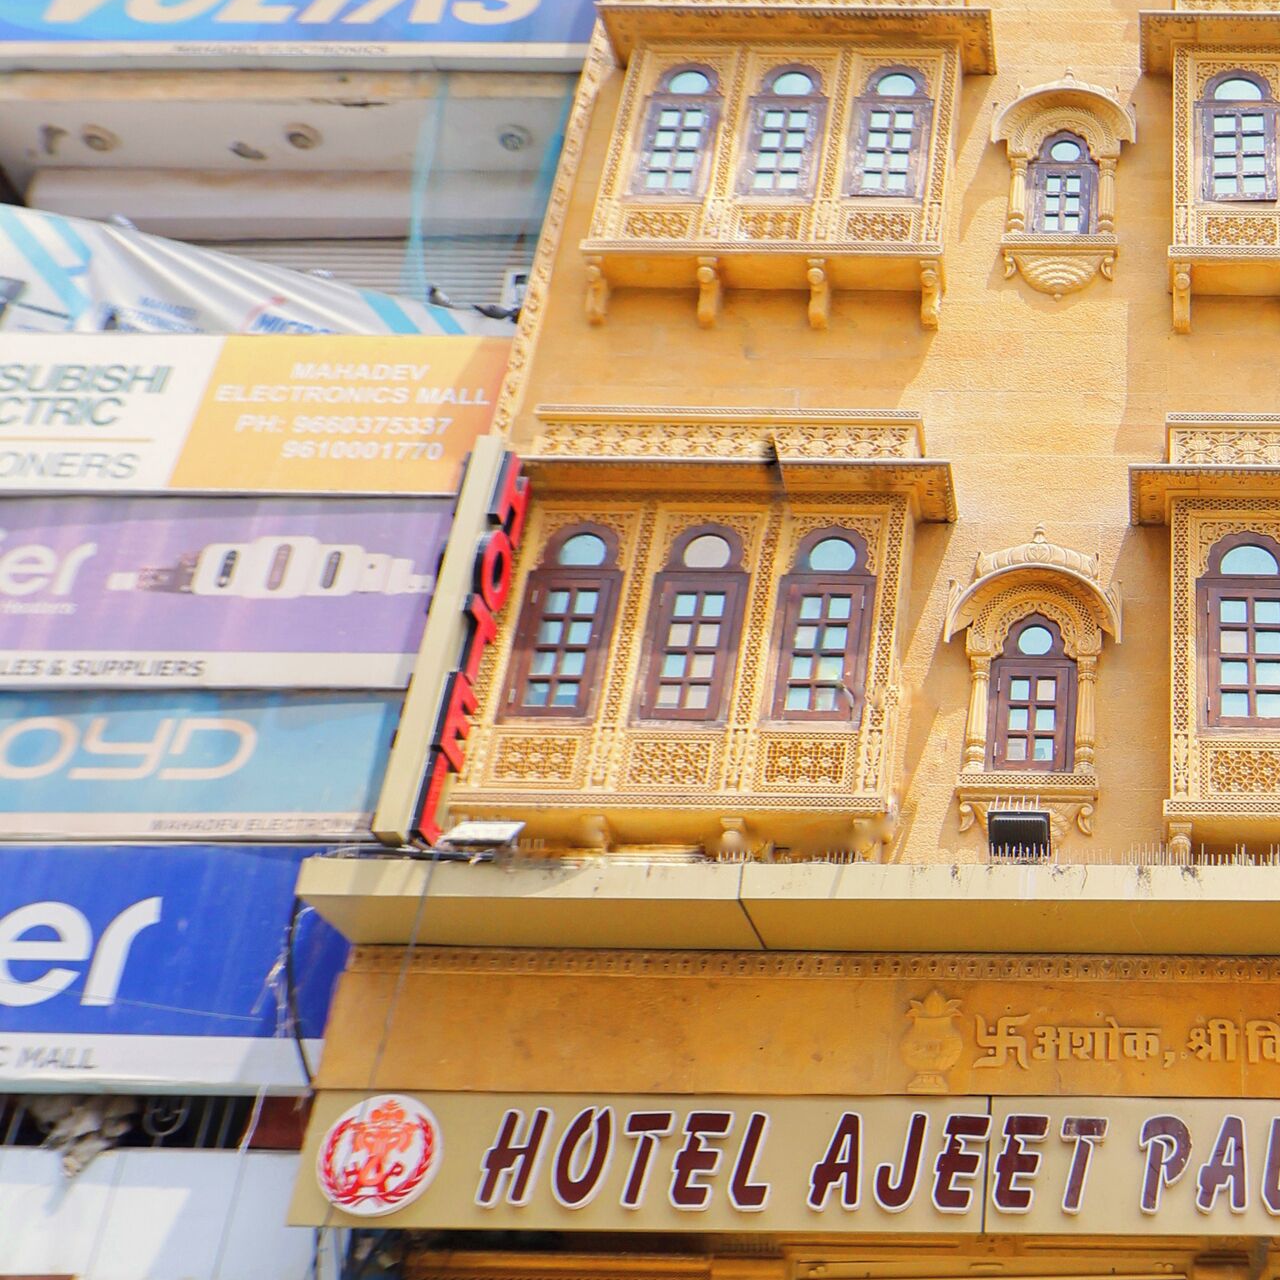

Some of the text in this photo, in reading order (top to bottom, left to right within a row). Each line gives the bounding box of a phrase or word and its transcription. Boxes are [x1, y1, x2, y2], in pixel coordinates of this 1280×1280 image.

[290, 363, 430, 381] MAHADEV
[215, 384, 490, 405] ELECTRONICS MALL
[71, 660, 207, 677] SUPPLIERS
[1186, 1018, 1240, 1062] श्री
[15, 1046, 98, 1069] MALL
[474, 1105, 770, 1211] HOTEL
[806, 1111, 1110, 1215] AJEET
